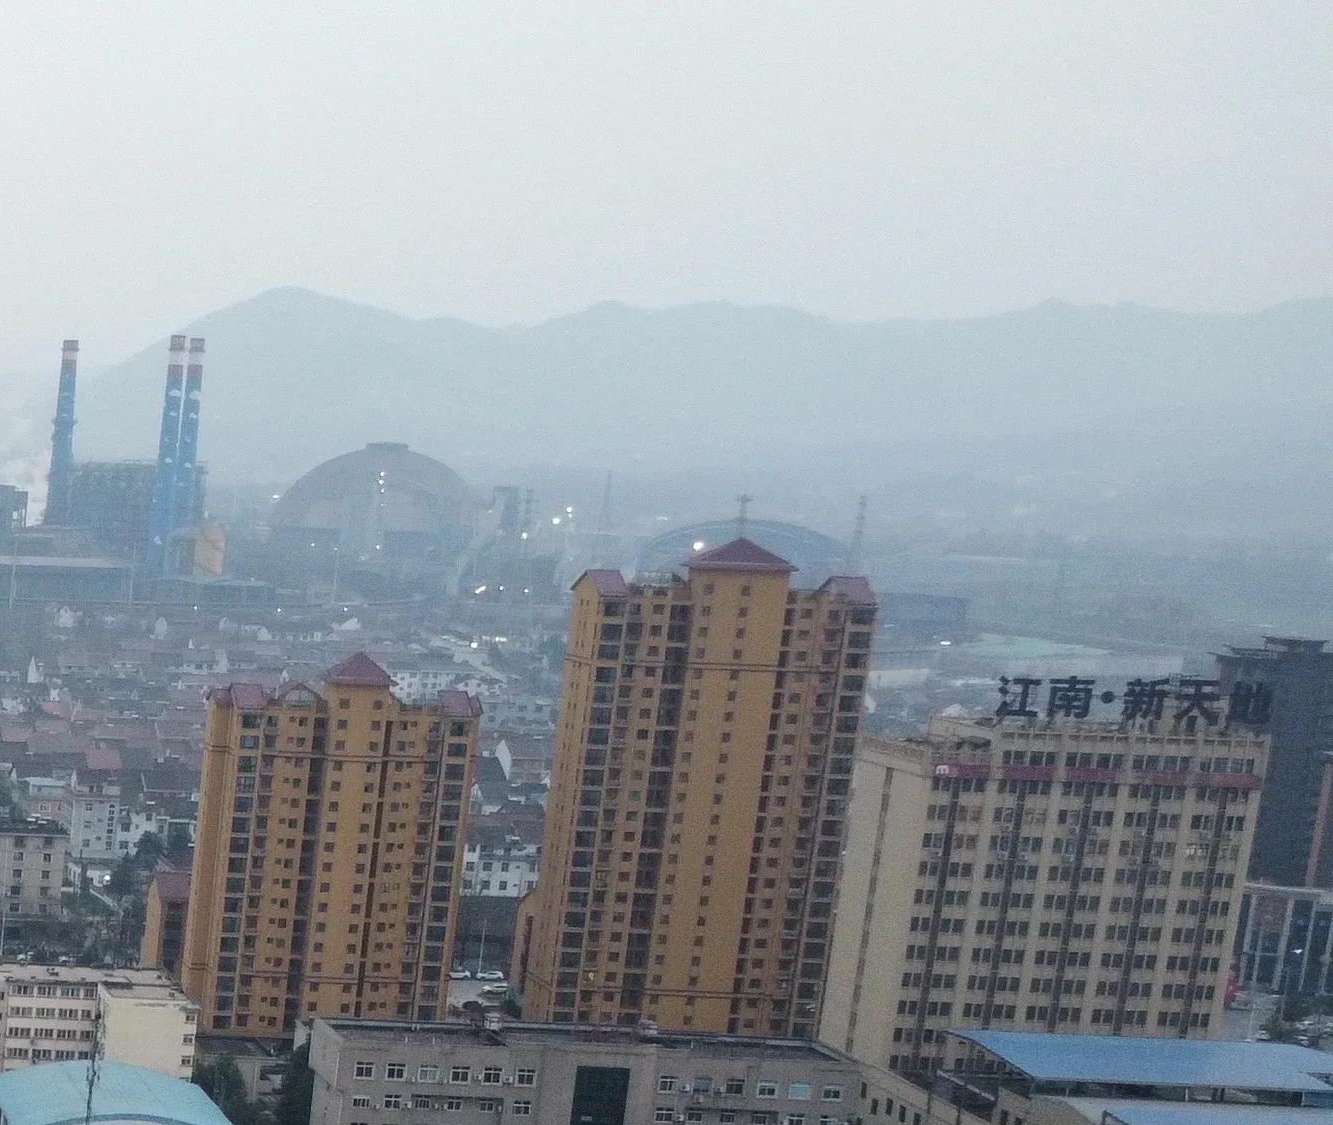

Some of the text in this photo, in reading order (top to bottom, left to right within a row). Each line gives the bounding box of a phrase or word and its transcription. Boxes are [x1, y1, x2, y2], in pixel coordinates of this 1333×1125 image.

[996, 676, 1273, 727] 江南·新天地
